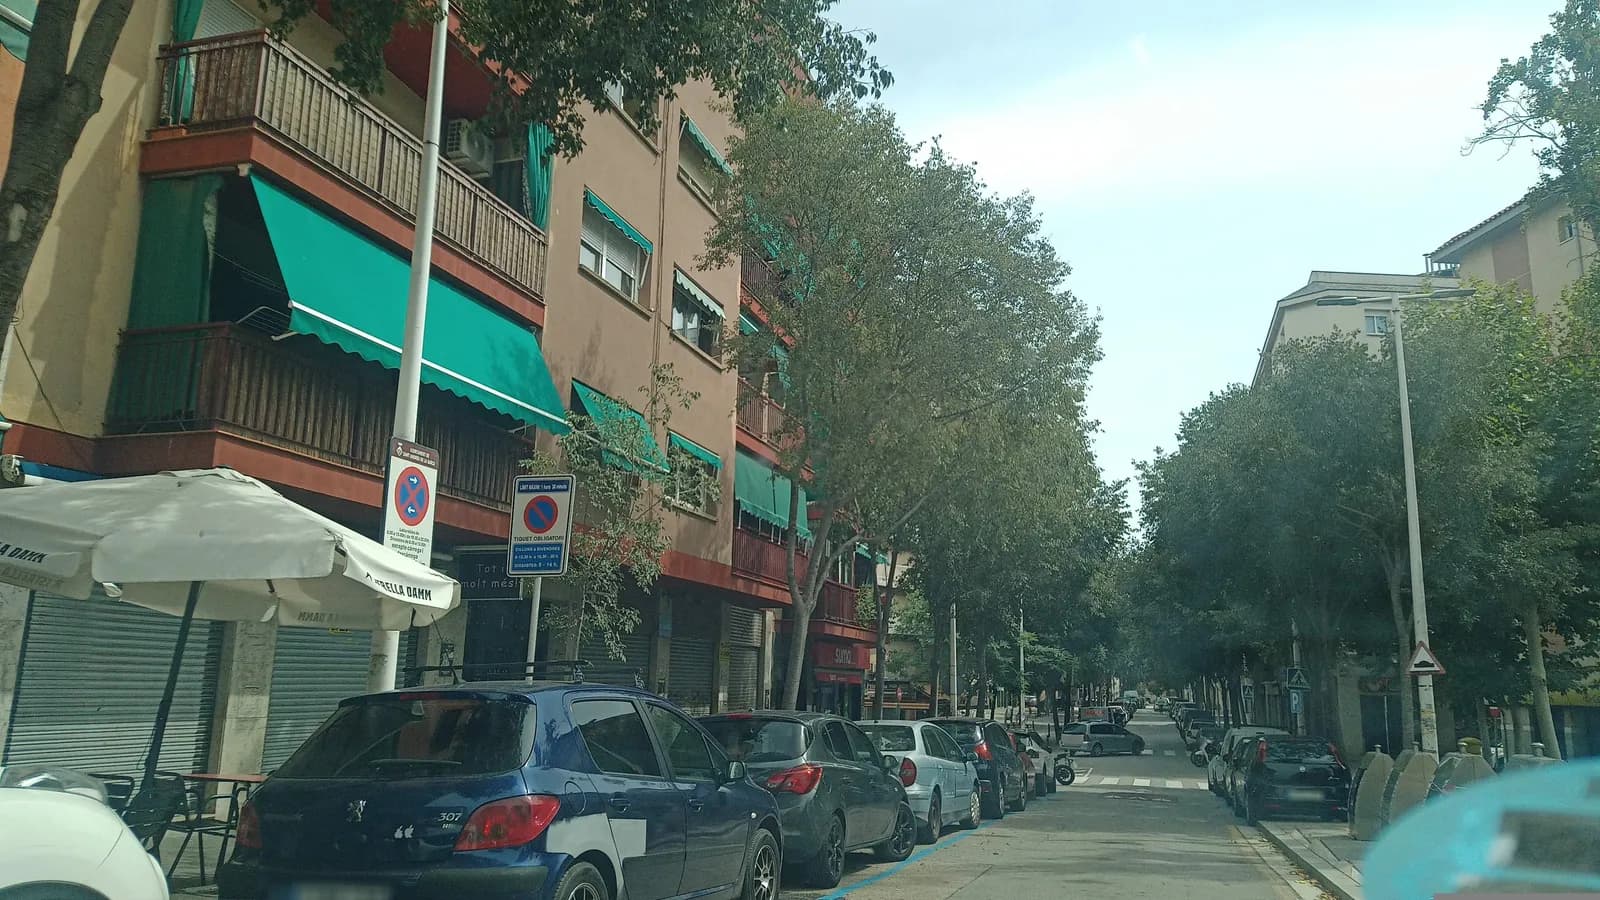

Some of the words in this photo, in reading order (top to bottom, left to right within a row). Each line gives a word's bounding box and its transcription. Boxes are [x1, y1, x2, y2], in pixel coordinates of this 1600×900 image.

[8, 546, 48, 563] DAMM
[406, 586, 432, 601] DAMM
[1292, 692, 1299, 710] P
[438, 812, 464, 822] 307
